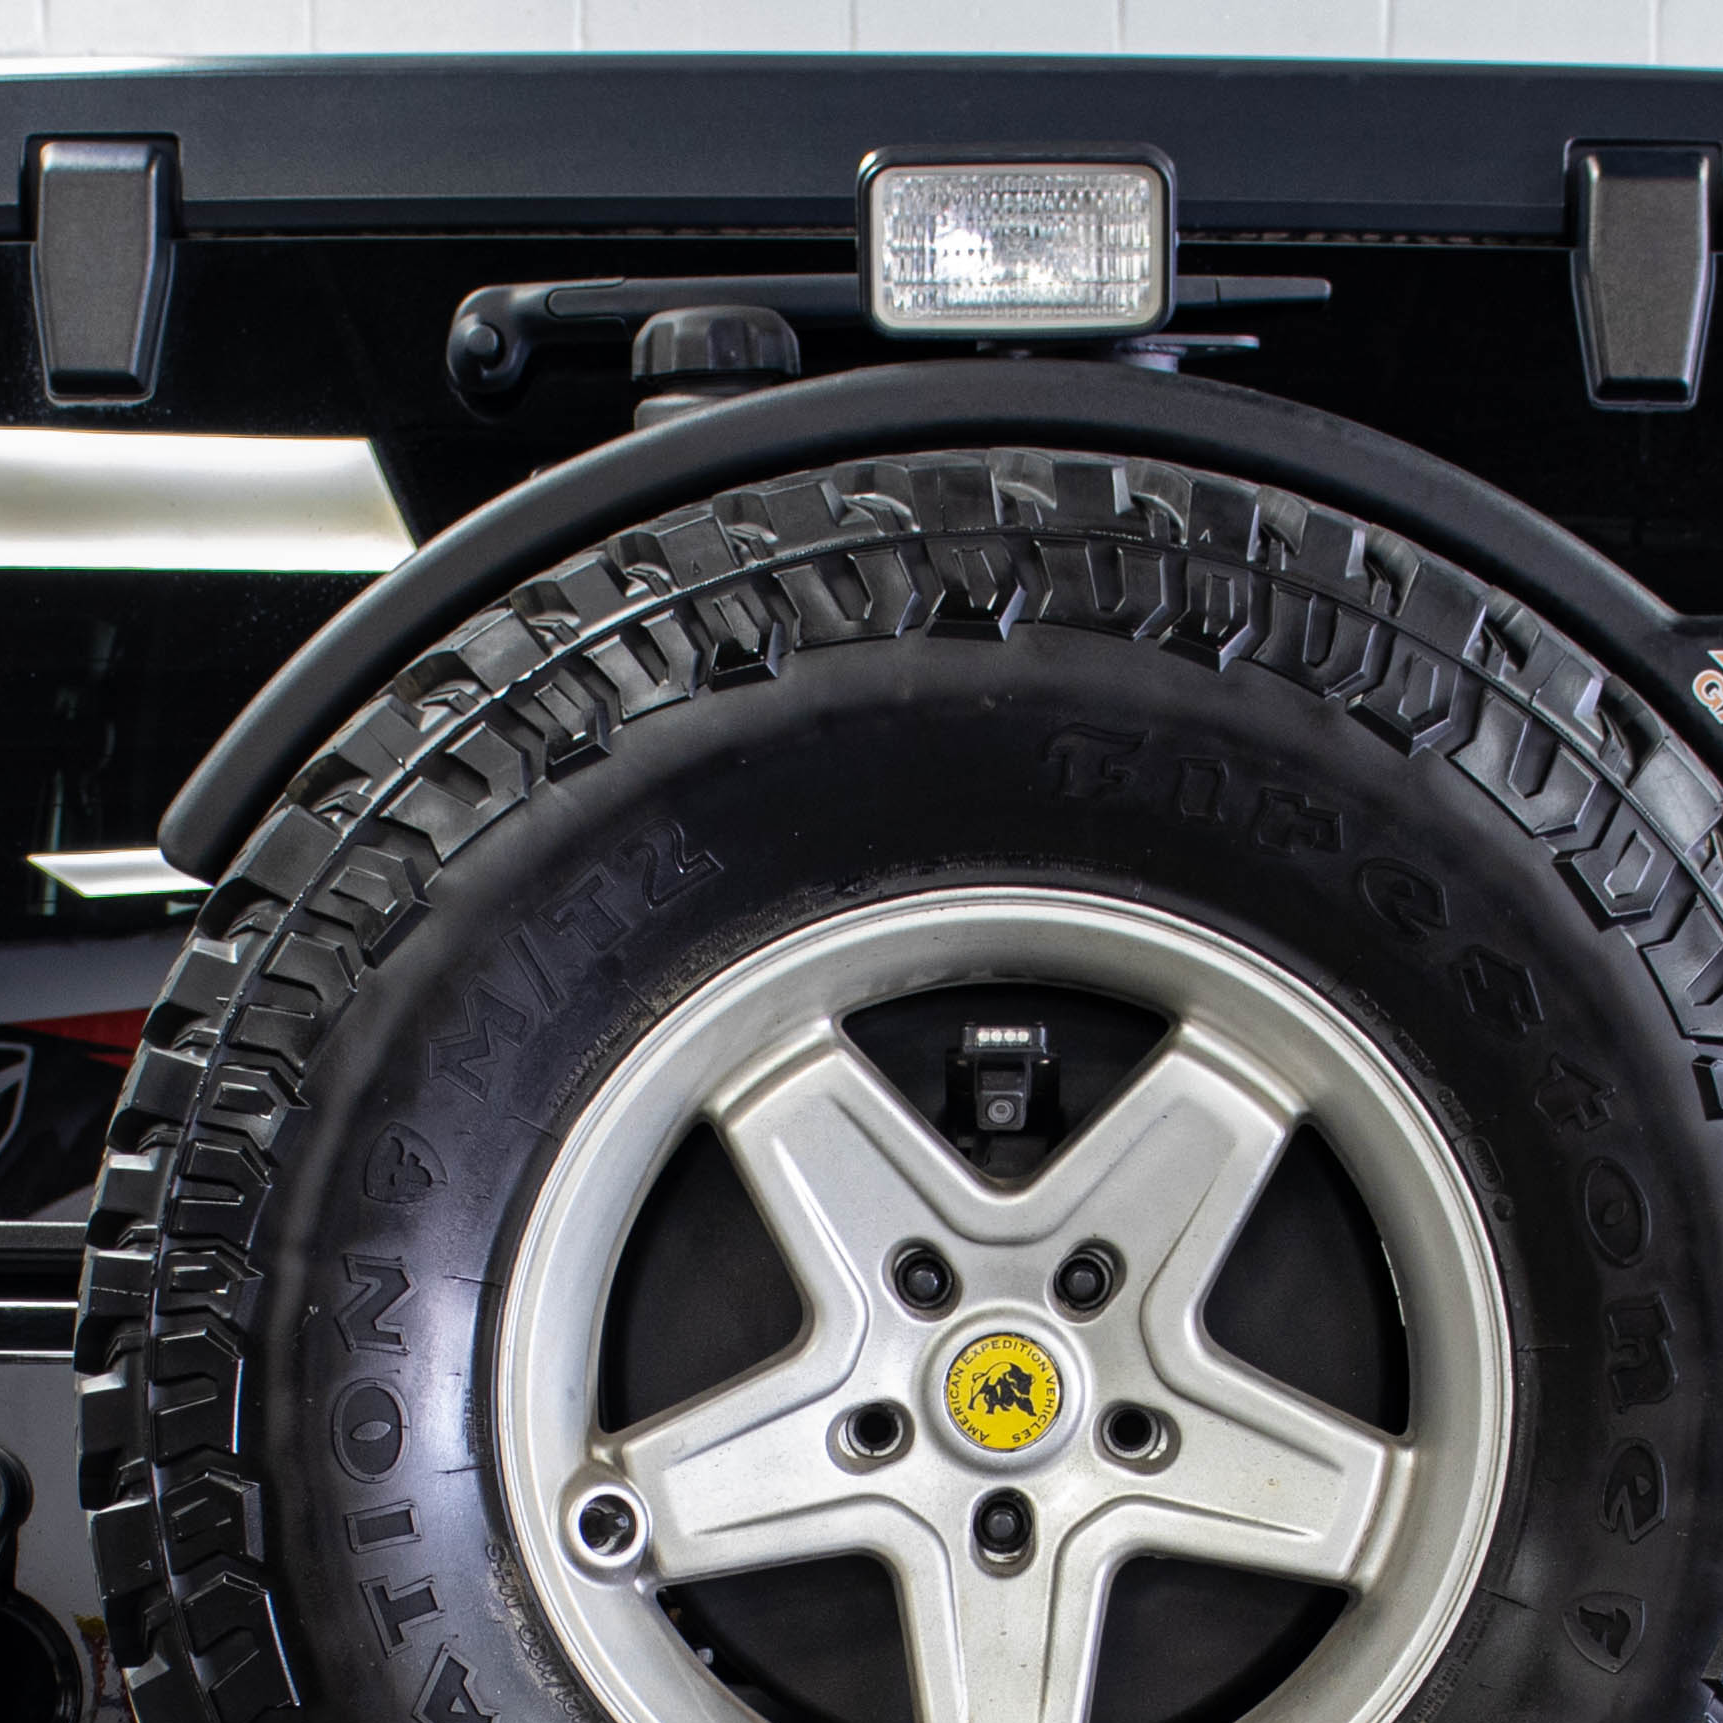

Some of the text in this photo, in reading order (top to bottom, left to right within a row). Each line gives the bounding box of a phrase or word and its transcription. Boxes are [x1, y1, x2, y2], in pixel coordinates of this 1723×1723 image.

[949, 1339, 1057, 1443] AMERICAN EXPEDITION VEHICLES
